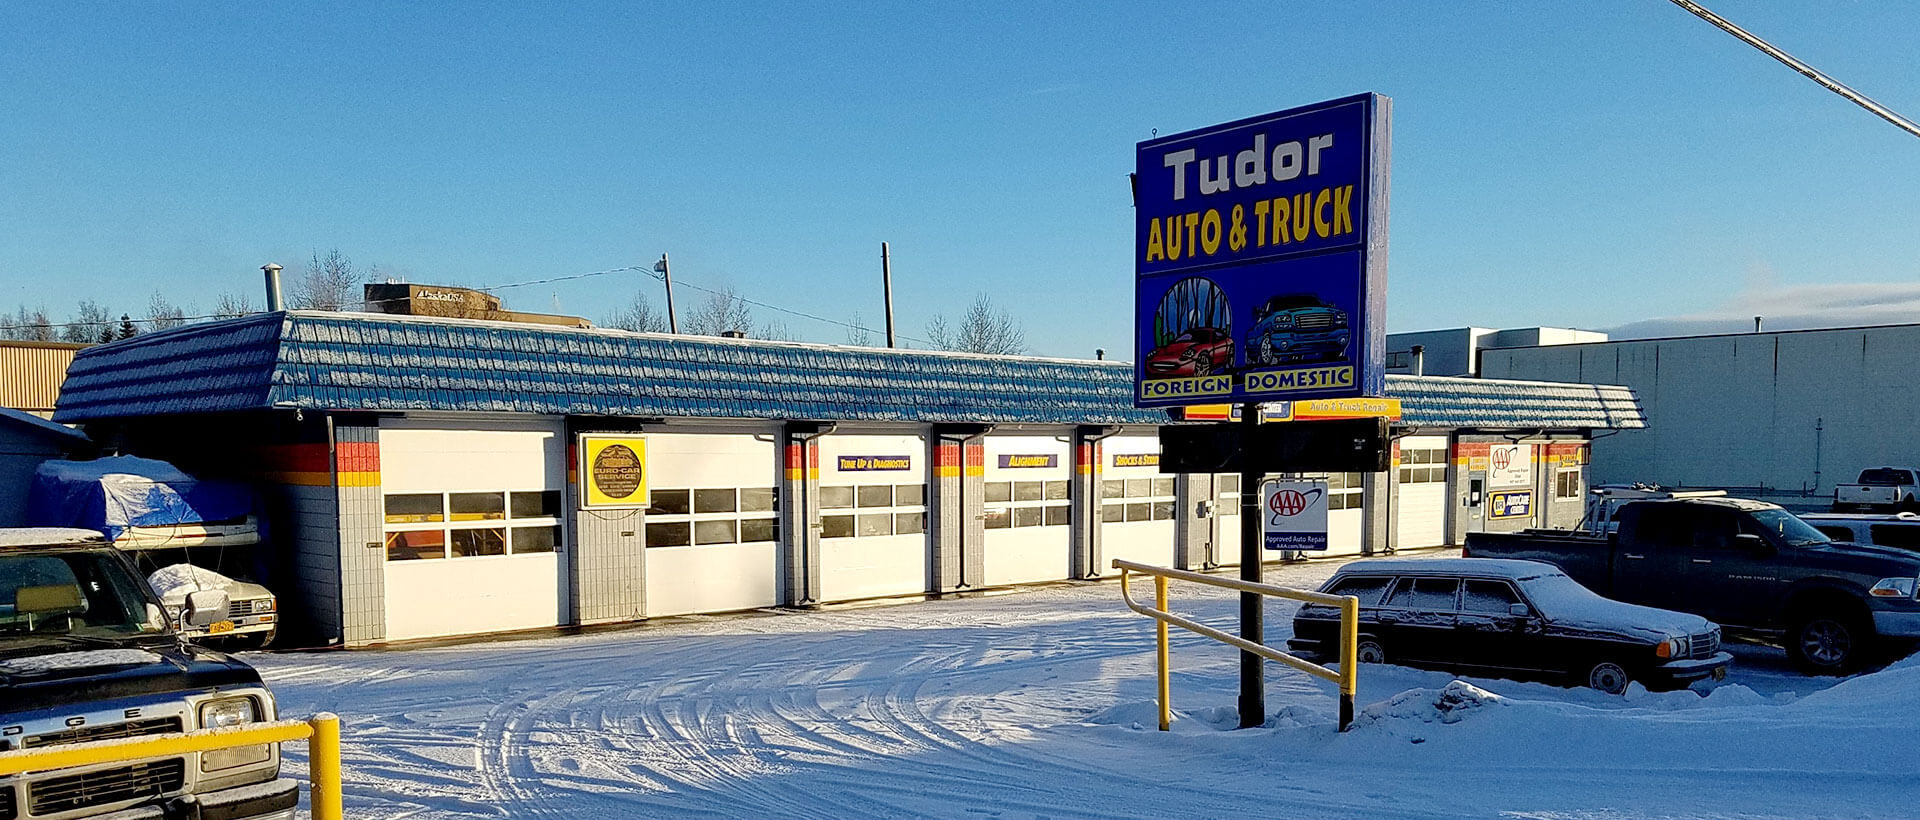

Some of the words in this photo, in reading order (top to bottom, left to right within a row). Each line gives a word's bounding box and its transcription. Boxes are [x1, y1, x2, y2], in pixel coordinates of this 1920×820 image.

[1164, 133, 1333, 200] Tudor
[1146, 208, 1222, 262] AUTO
[1228, 203, 1247, 251] &
[1254, 184, 1353, 247] TRUCK
[1144, 377, 1230, 396] FOREIGN
[1248, 368, 1350, 389] DOMESTIC
[1311, 402, 1329, 411] Auto
[1339, 402, 1361, 411] Truck
[1363, 402, 1387, 413] Repair
[1143, 455, 1159, 465] STRUT
[1273, 490, 1303, 515] AAA
[2, 708, 142, 737] DGE
